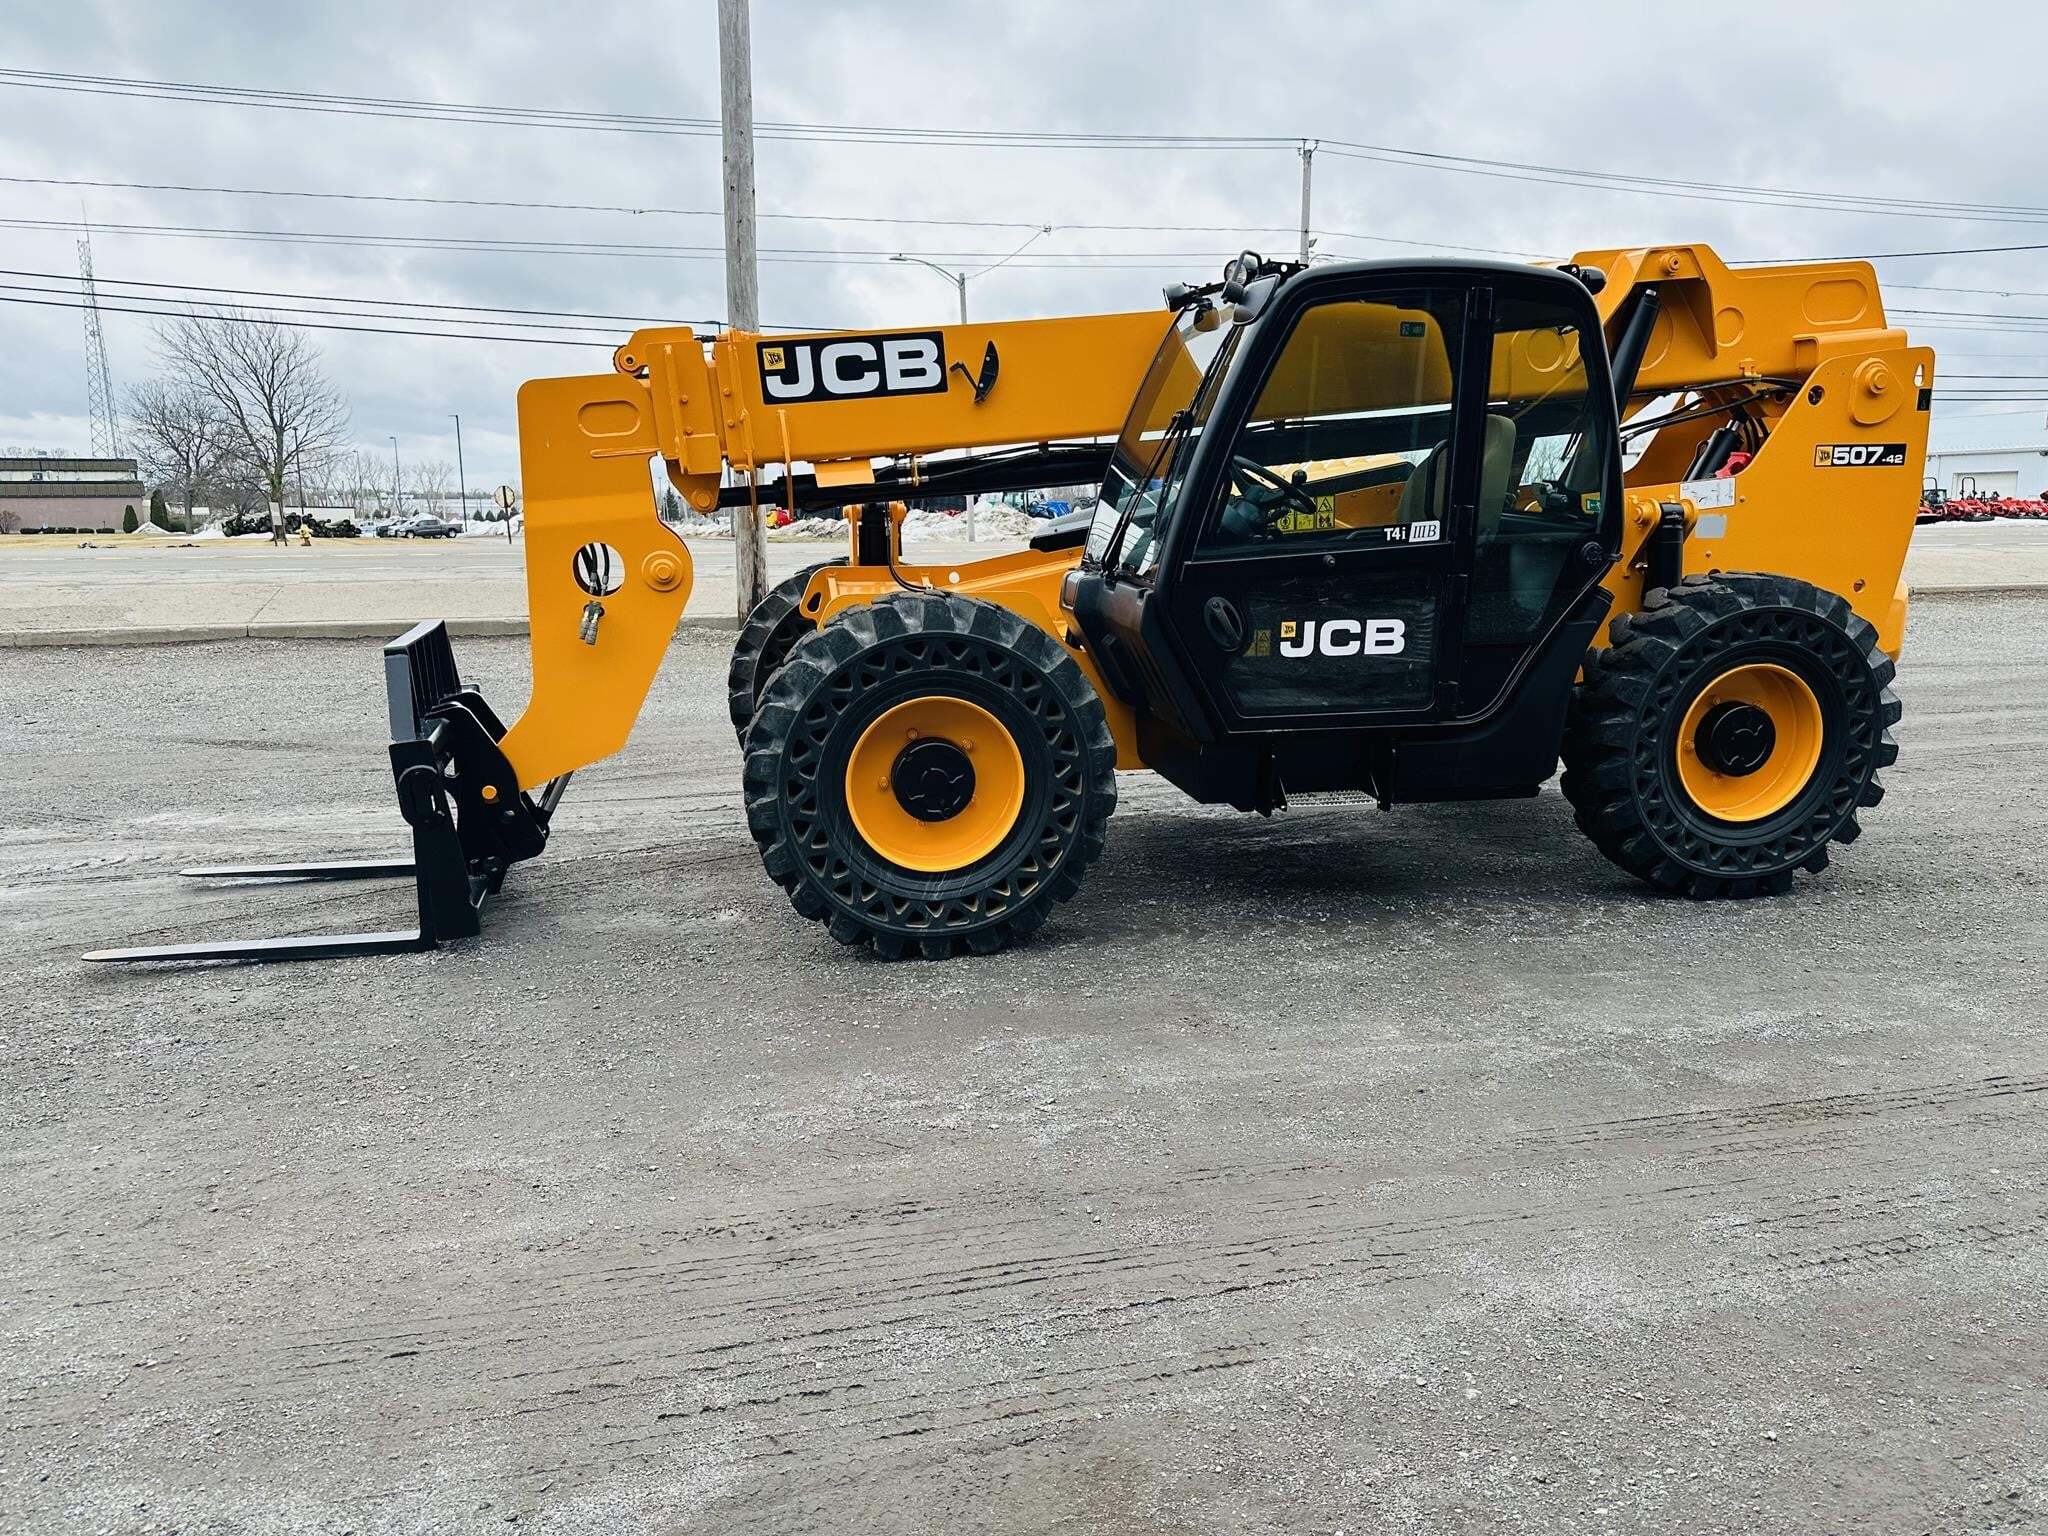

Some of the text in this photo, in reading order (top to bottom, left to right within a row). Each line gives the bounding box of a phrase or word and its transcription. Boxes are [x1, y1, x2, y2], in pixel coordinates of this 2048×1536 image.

[765, 338, 942, 398] JCB
[1383, 526, 1406, 541] T4i
[1279, 619, 1406, 658] JCB
